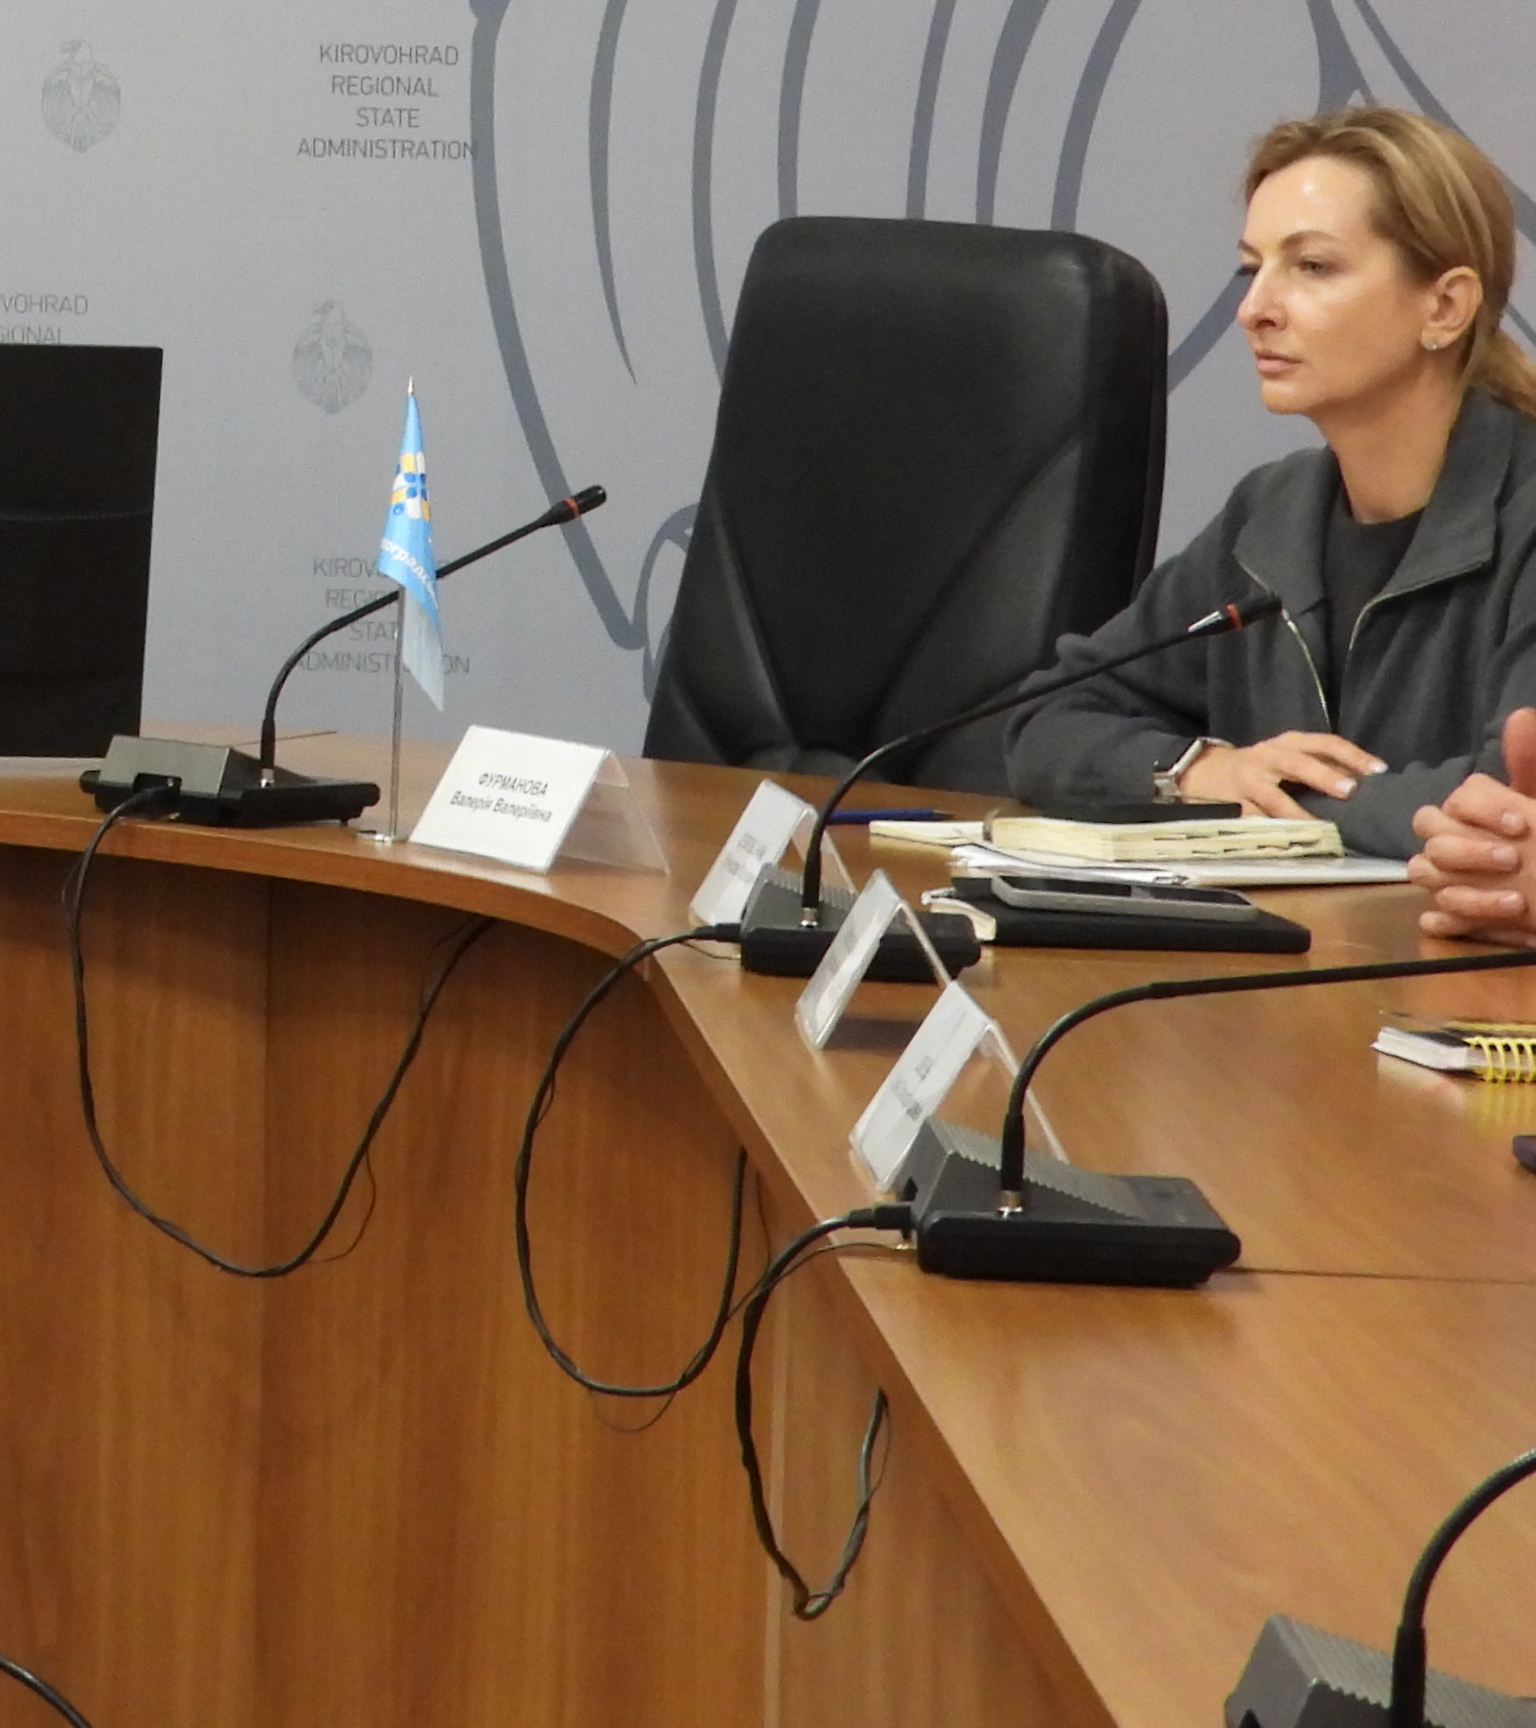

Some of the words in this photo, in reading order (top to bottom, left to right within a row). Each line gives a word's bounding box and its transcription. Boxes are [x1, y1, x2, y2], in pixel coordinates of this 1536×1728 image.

[320, 44, 459, 66] KIROVOHRAD
[330, 74, 439, 98] REGIONAL
[356, 106, 420, 129] STATE
